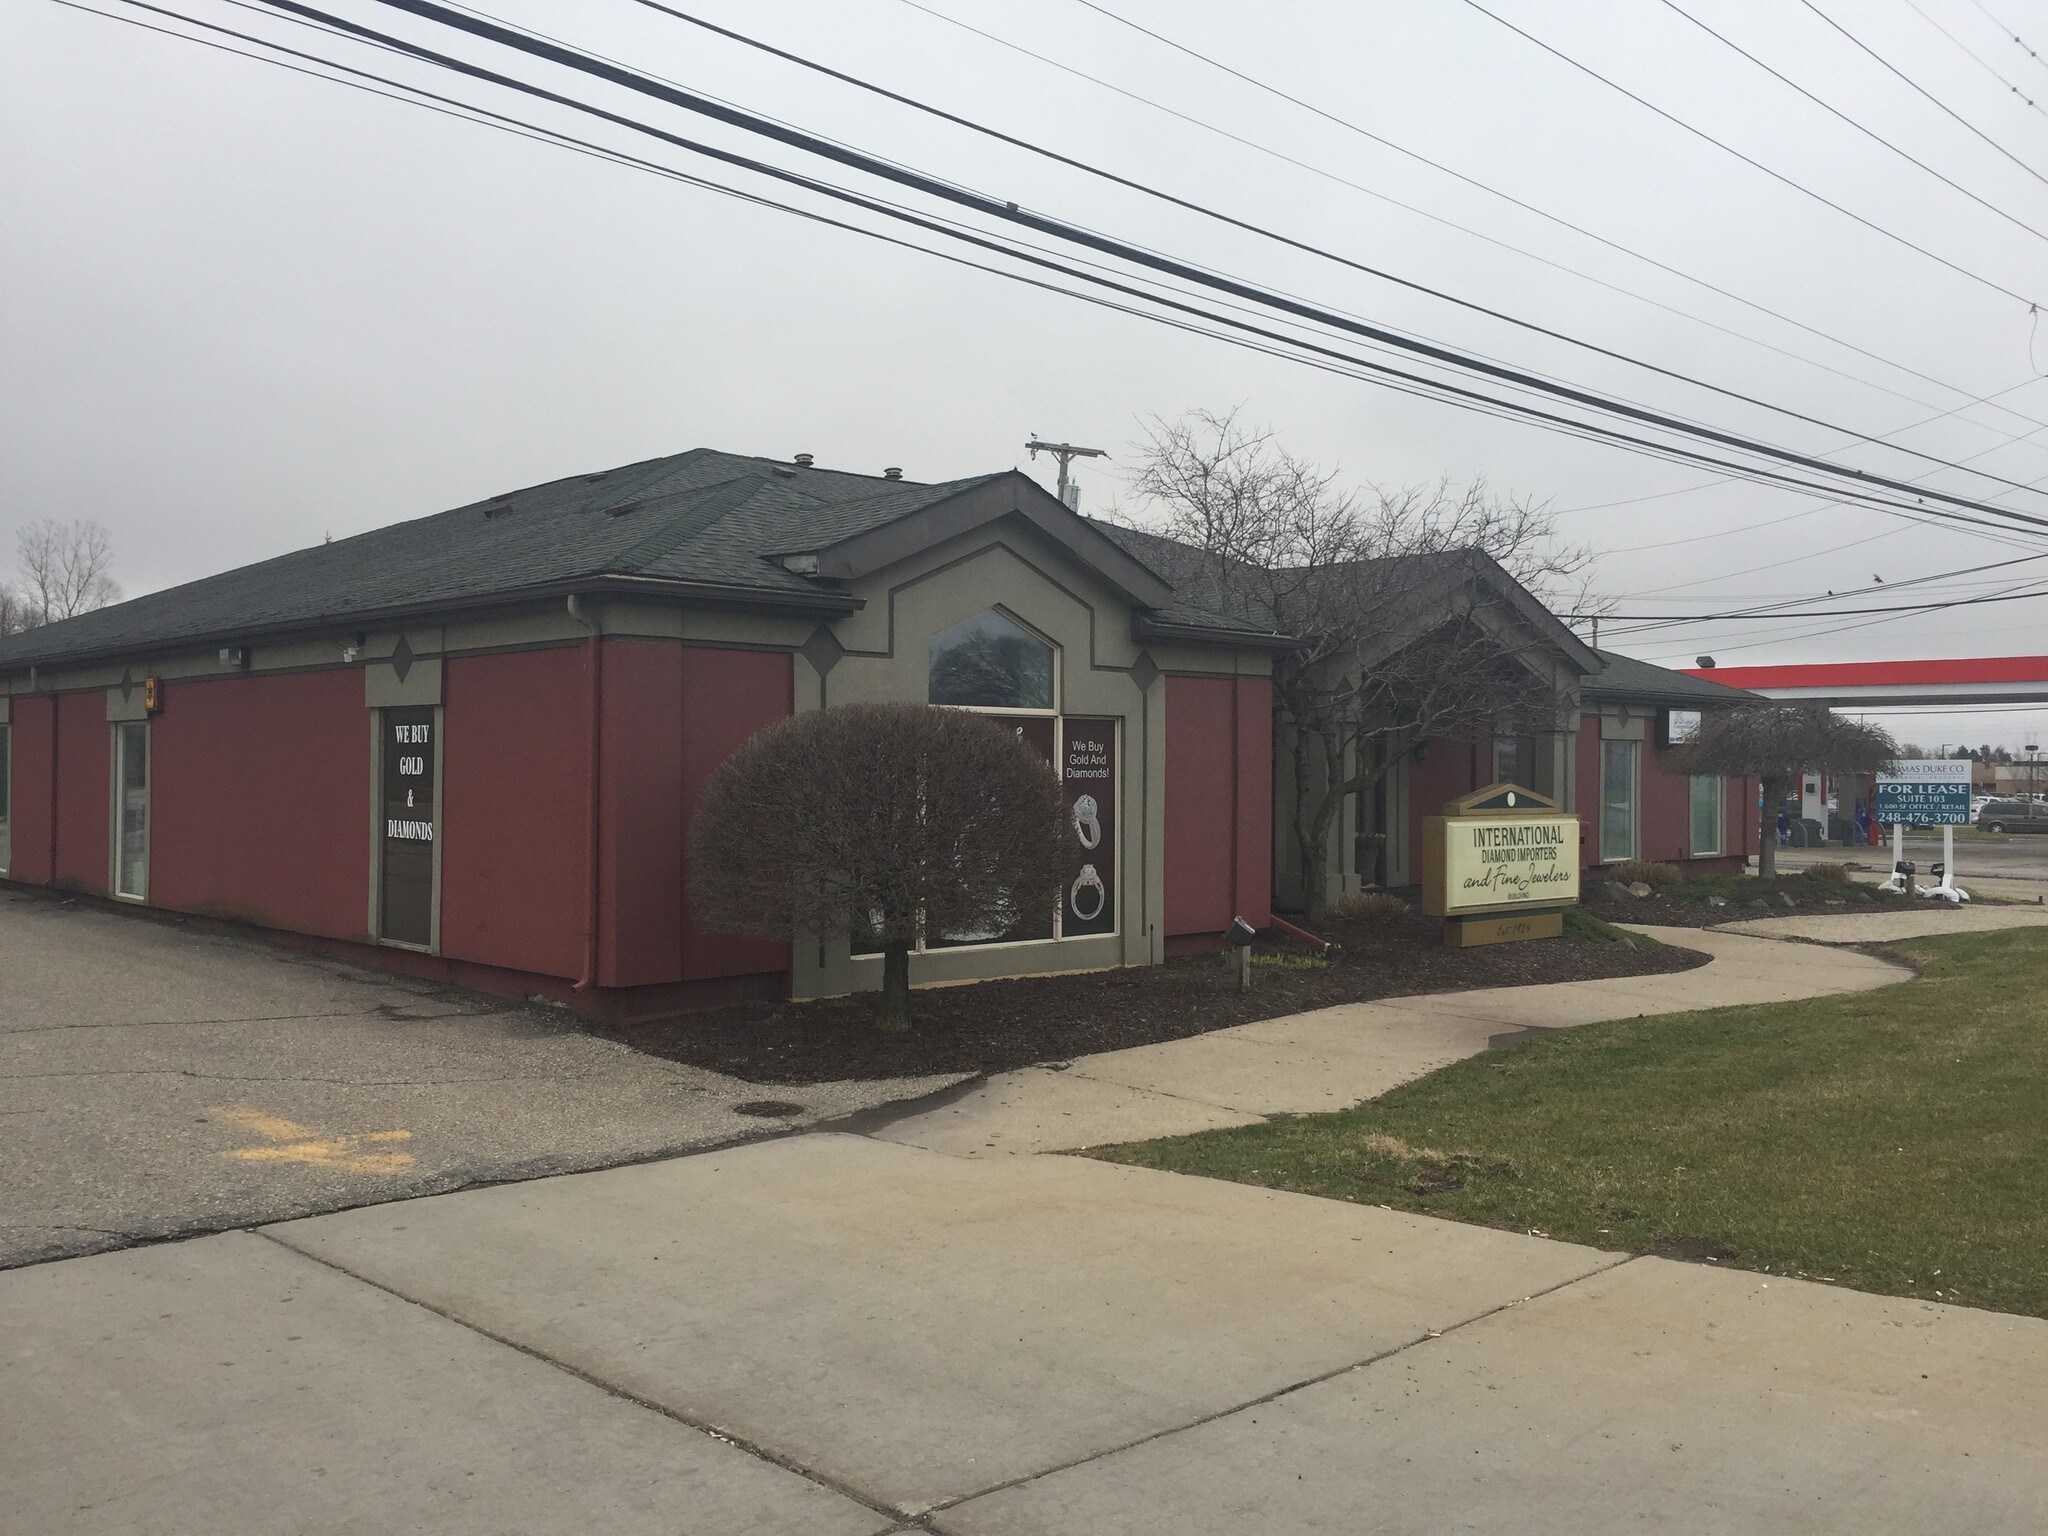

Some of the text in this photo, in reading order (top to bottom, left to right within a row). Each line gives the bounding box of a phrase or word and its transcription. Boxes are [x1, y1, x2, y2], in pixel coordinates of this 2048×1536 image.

[395, 725, 430, 743] WE BUY
[1072, 740, 1104, 754] We Buy
[399, 756, 424, 775] GOLD
[1069, 754, 1107, 765] Gold And
[1066, 767, 1109, 779] Diamonds!
[1923, 765, 1947, 773] DUKE
[1879, 784, 1967, 794] FOR LEASE
[407, 788, 414, 808] &
[1897, 795, 1946, 803] SUITE 103
[1941, 803, 1966, 811] RETAIL
[1878, 812, 1966, 824] 248-476-3700
[388, 820, 433, 841] DIAMONDS
[1473, 825, 1564, 848] INTERNATIONAL
[1481, 846, 1557, 864] DIAMOND IMPORTERS
[1463, 862, 1571, 892] and Fine Jewelers
